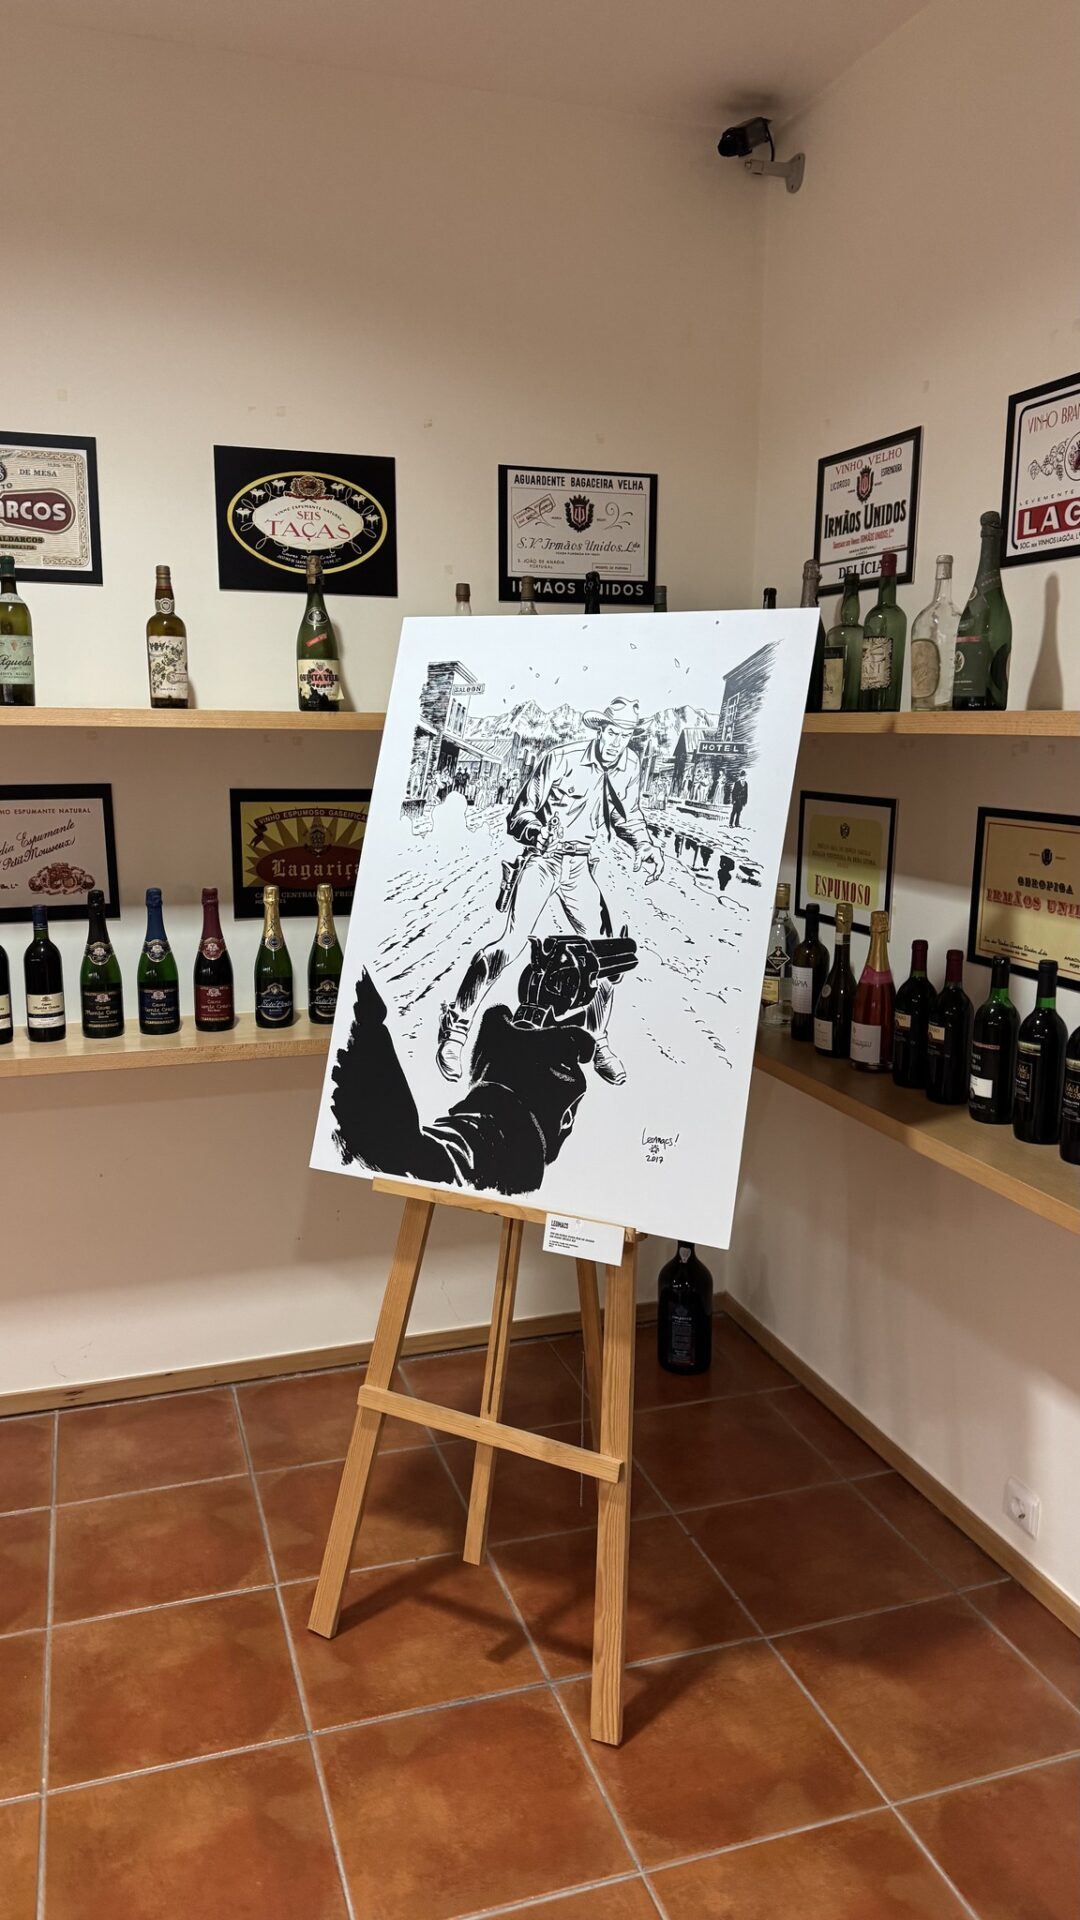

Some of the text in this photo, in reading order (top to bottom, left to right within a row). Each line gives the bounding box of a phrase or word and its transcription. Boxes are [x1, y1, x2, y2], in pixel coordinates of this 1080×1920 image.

[1027, 410, 1058, 434] VINHO
[835, 447, 903, 475] VINHO VELHO
[19, 468, 57, 477] DE MESA
[514, 474, 644, 491] AGUARDENTE BAGACEIRA VELHA
[1019, 489, 1076, 506] LEVEMENTE
[296, 510, 321, 521] SEIS
[824, 499, 907, 539] IRMÃOS UNIDOS
[265, 519, 352, 542] TAÇAS
[541, 538, 583, 550] Irmãos
[512, 578, 577, 595] IMÃOS
[584, 581, 645, 597] IDOS
[454, 685, 483, 693] SALOON
[702, 744, 740, 752] HOTEL
[283, 810, 325, 818] ESPUMOSO
[16, 818, 76, 850] Espumante
[815, 874, 871, 906] ESPUMOSO
[986, 888, 1042, 911] IRMÃOS
[645, 1154, 664, 1164] 2017
